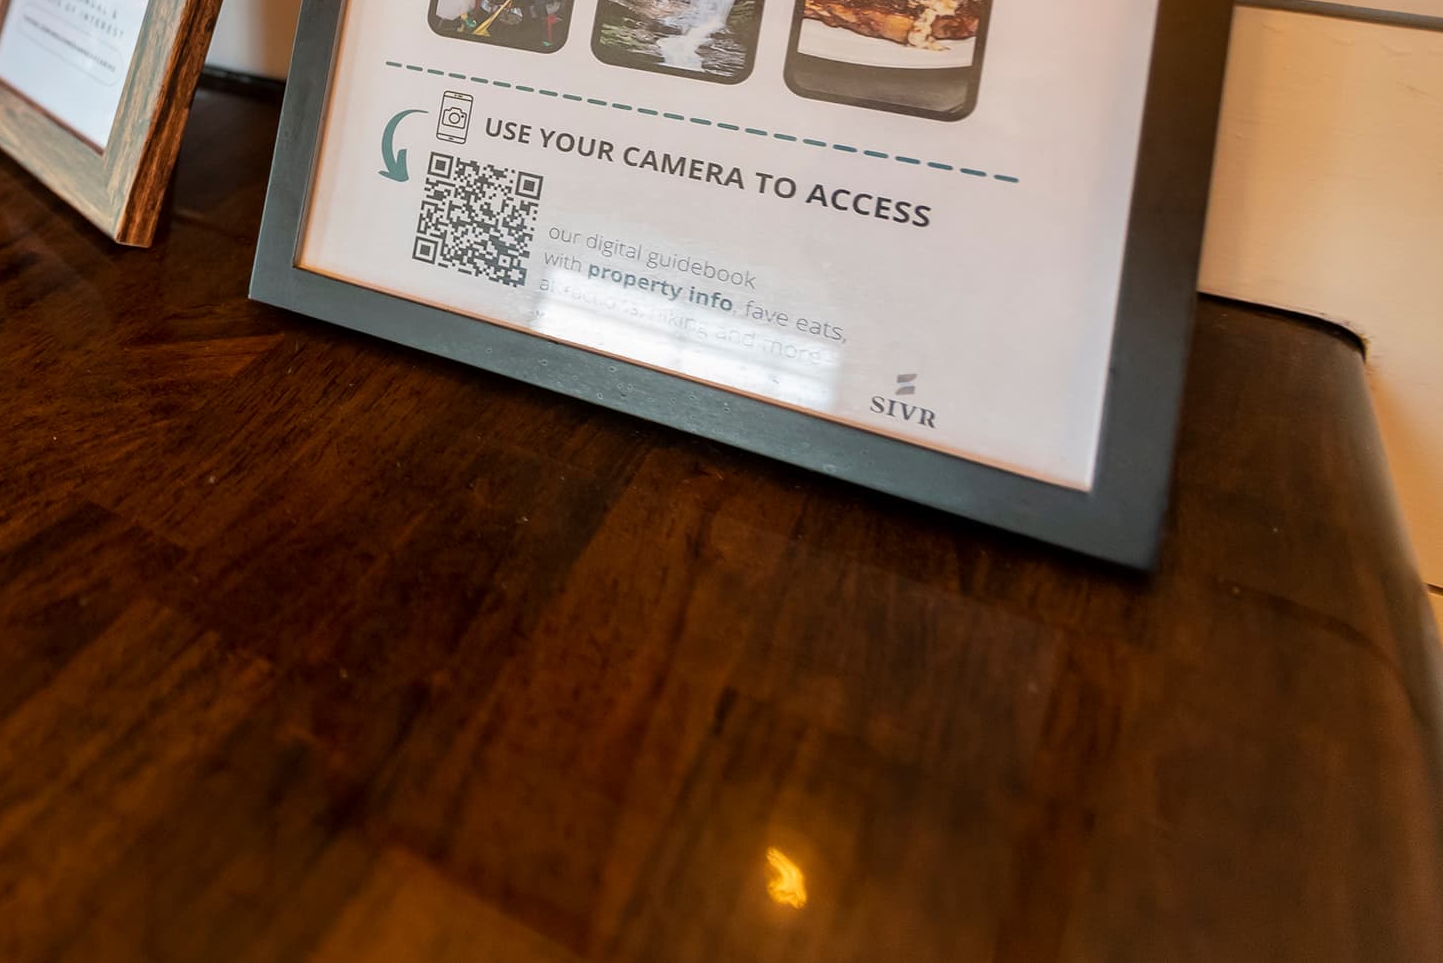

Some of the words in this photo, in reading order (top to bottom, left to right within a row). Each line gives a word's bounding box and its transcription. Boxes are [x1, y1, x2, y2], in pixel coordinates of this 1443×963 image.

[484, 117, 533, 146] USE
[540, 128, 615, 163] YOUR
[622, 145, 745, 191] CAMERA
[753, 171, 797, 200] TO
[804, 183, 932, 229] ACCESS
[549, 226, 581, 244] our
[586, 233, 642, 261] digital
[646, 250, 756, 289] guidebook
[543, 250, 582, 272] with
[588, 261, 683, 301] property
[688, 286, 738, 314] info,
[745, 300, 789, 327] fave
[796, 318, 847, 344] eats,
[869, 395, 935, 429] SIVR
